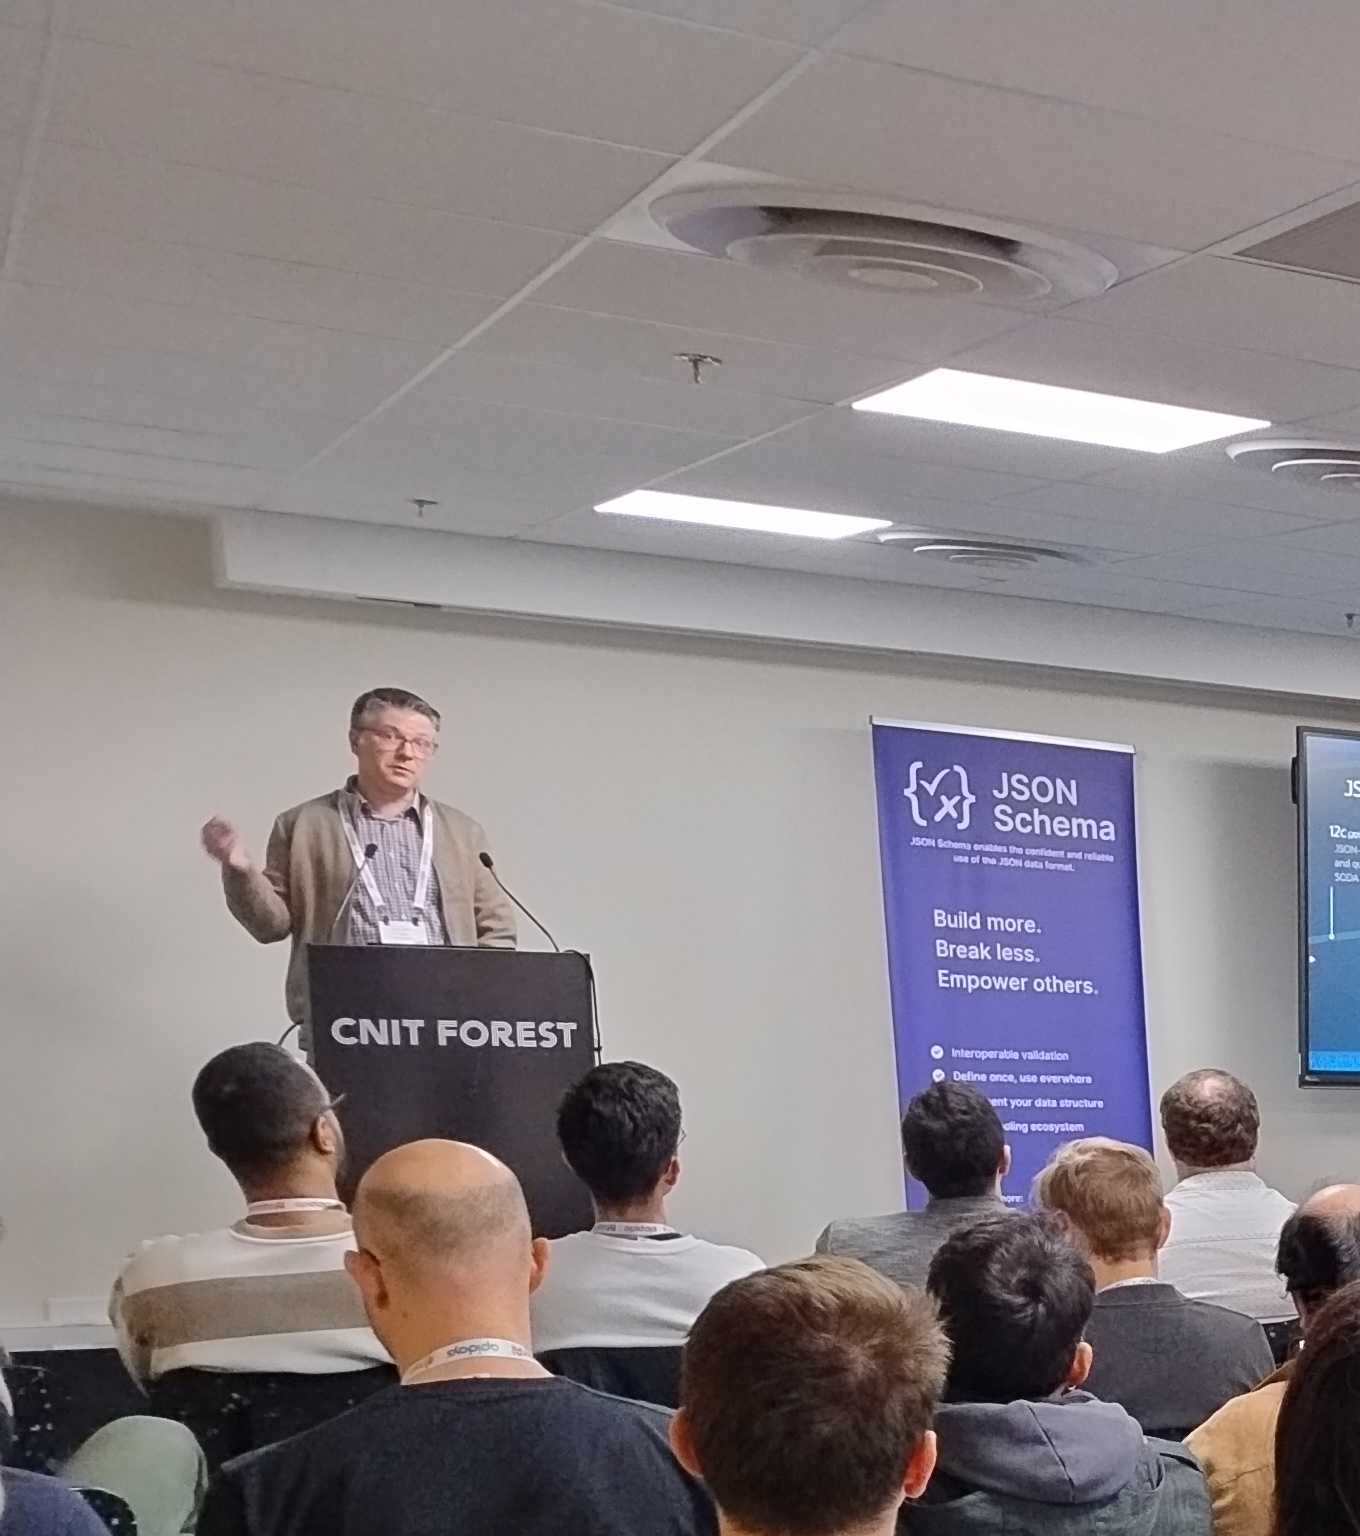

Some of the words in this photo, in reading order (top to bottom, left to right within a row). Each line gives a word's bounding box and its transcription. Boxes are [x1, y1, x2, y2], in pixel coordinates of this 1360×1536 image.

[992, 772, 1078, 806] JSON
[993, 804, 1115, 841] Schema
[1329, 825, 1347, 839] 12c
[910, 836, 935, 847] JSON
[937, 839, 971, 851] Schema
[1009, 845, 1023, 855] the
[1067, 851, 1082, 860] and
[953, 854, 969, 863] use
[970, 854, 980, 864] of
[981, 856, 997, 865] the
[999, 857, 1023, 867] JSON
[1024, 860, 1043, 869] data
[1334, 860, 1351, 868] and
[934, 909, 981, 929] Build
[987, 915, 1042, 933] more.
[936, 939, 992, 960] Break
[997, 943, 1041, 963] less.
[938, 969, 1028, 994] Empower
[1033, 976, 1099, 995] others.
[331, 1017, 425, 1045] CNIT
[437, 1019, 577, 1048] FOREST
[951, 1047, 1019, 1064] Interoperable
[1021, 1050, 1069, 1062] validation
[953, 1071, 987, 1083] Define
[989, 1074, 1018, 1084] once,
[1019, 1074, 1038, 1083] use
[1011, 1098, 1032, 1109] your
[1035, 1098, 1057, 1107] data
[1059, 1098, 1104, 1109] structure
[1031, 1122, 1084, 1134] ecosystem
